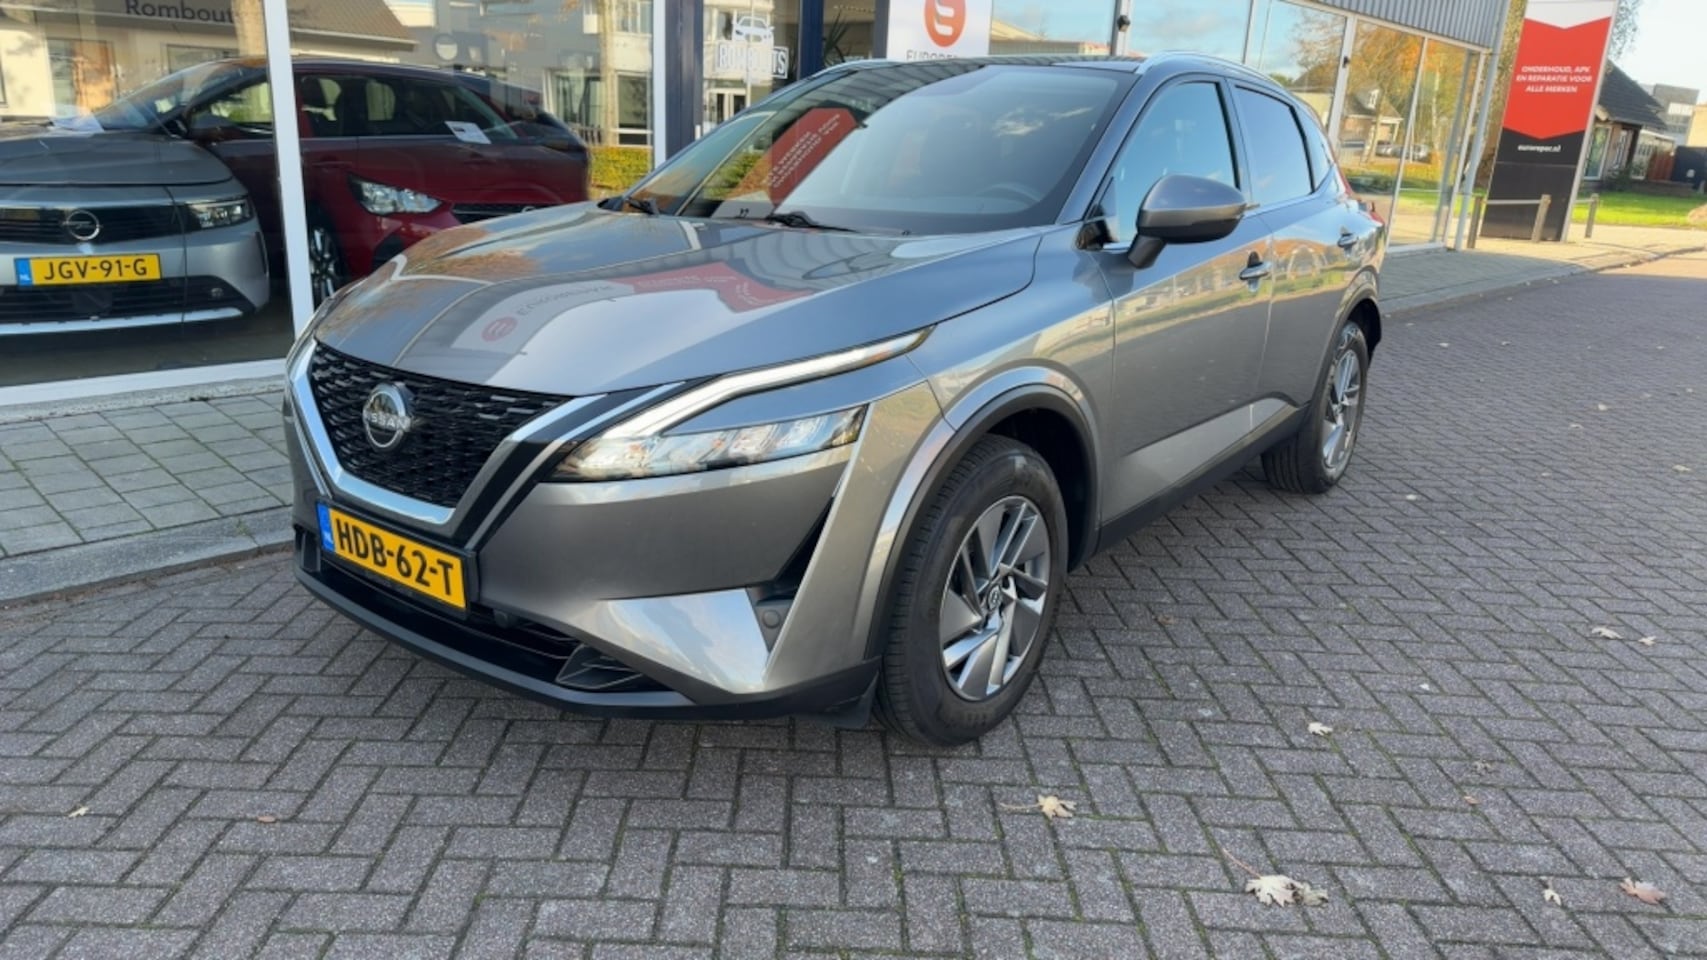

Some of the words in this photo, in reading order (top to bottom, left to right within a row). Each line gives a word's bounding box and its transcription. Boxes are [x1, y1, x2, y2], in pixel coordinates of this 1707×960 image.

[126, 0, 235, 23] Rombout
[1521, 66, 1572, 74] ONDERHOUD,
[1545, 85, 1578, 93] MERKEN
[44, 258, 147, 280] JGV-91-G
[336, 518, 453, 596] HDB-62-T
